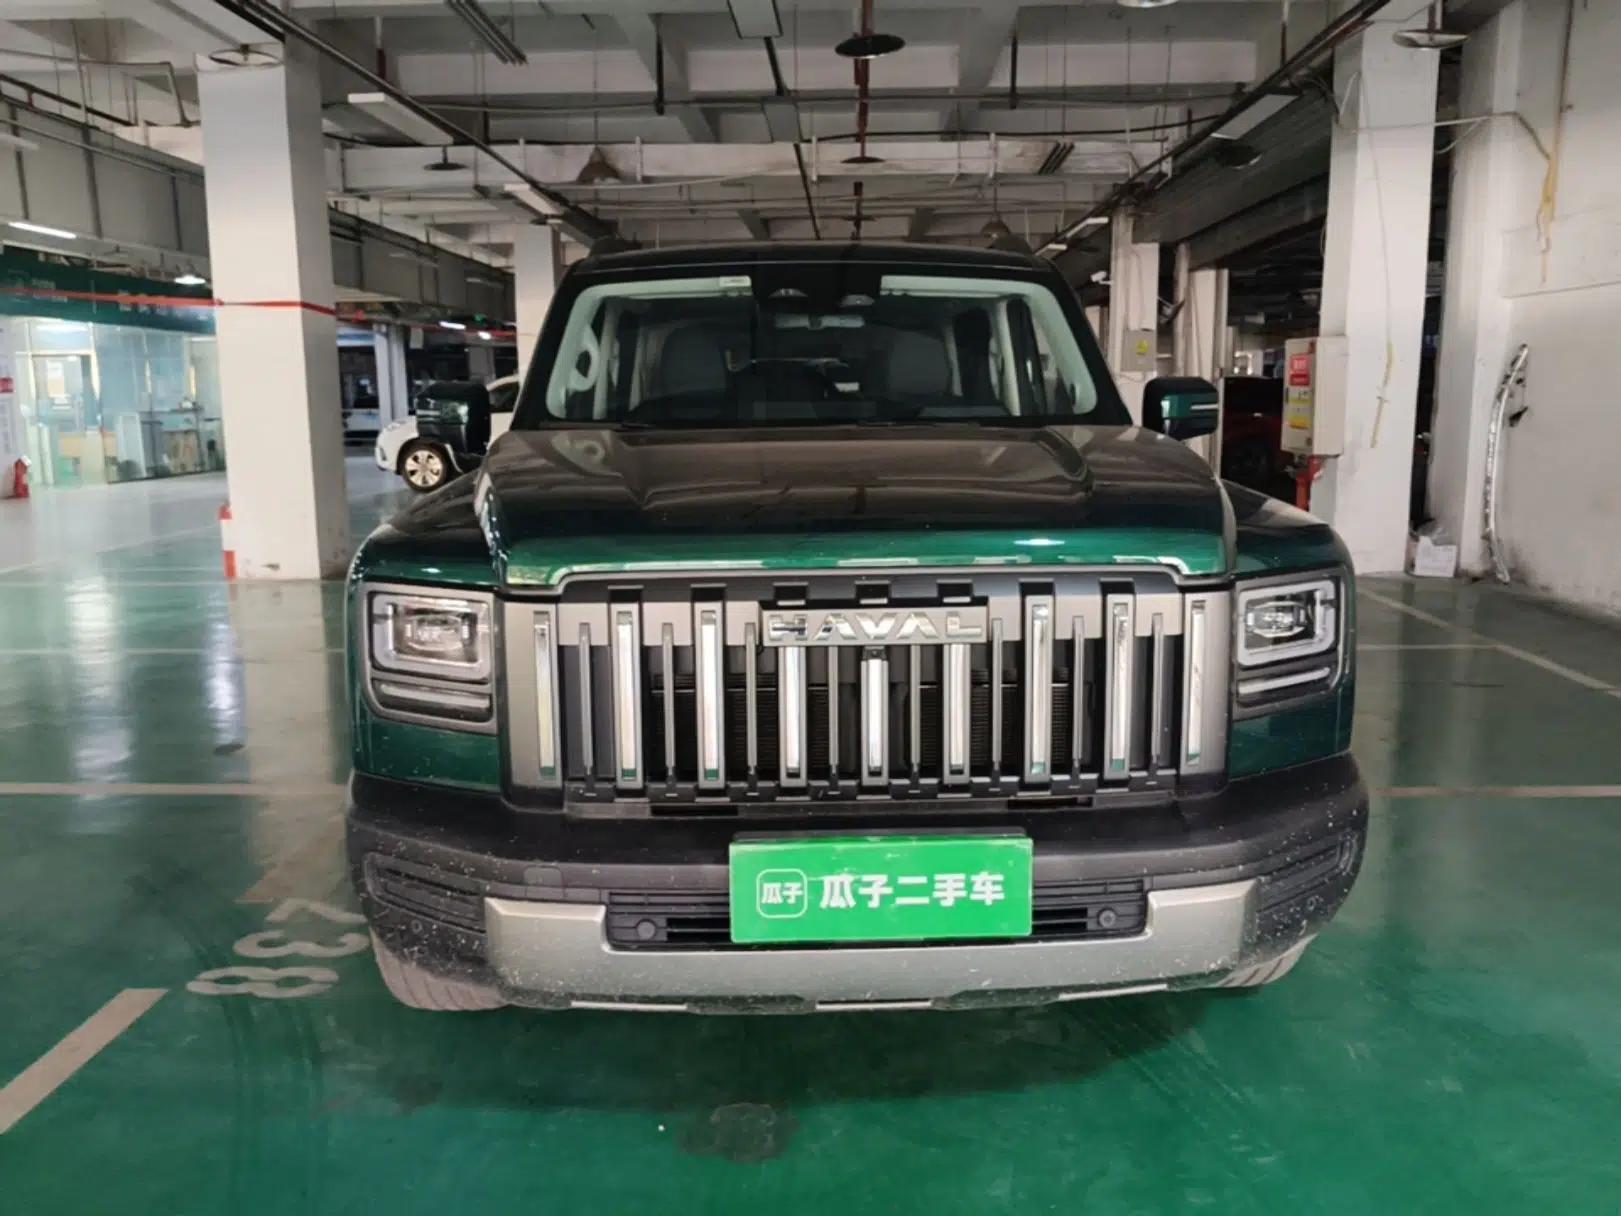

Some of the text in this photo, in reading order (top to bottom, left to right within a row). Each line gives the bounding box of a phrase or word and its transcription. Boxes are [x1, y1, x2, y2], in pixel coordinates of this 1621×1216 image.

[768, 610, 982, 641] HAVAL
[760, 871, 1006, 909] 瓜子 瓜子二手车
